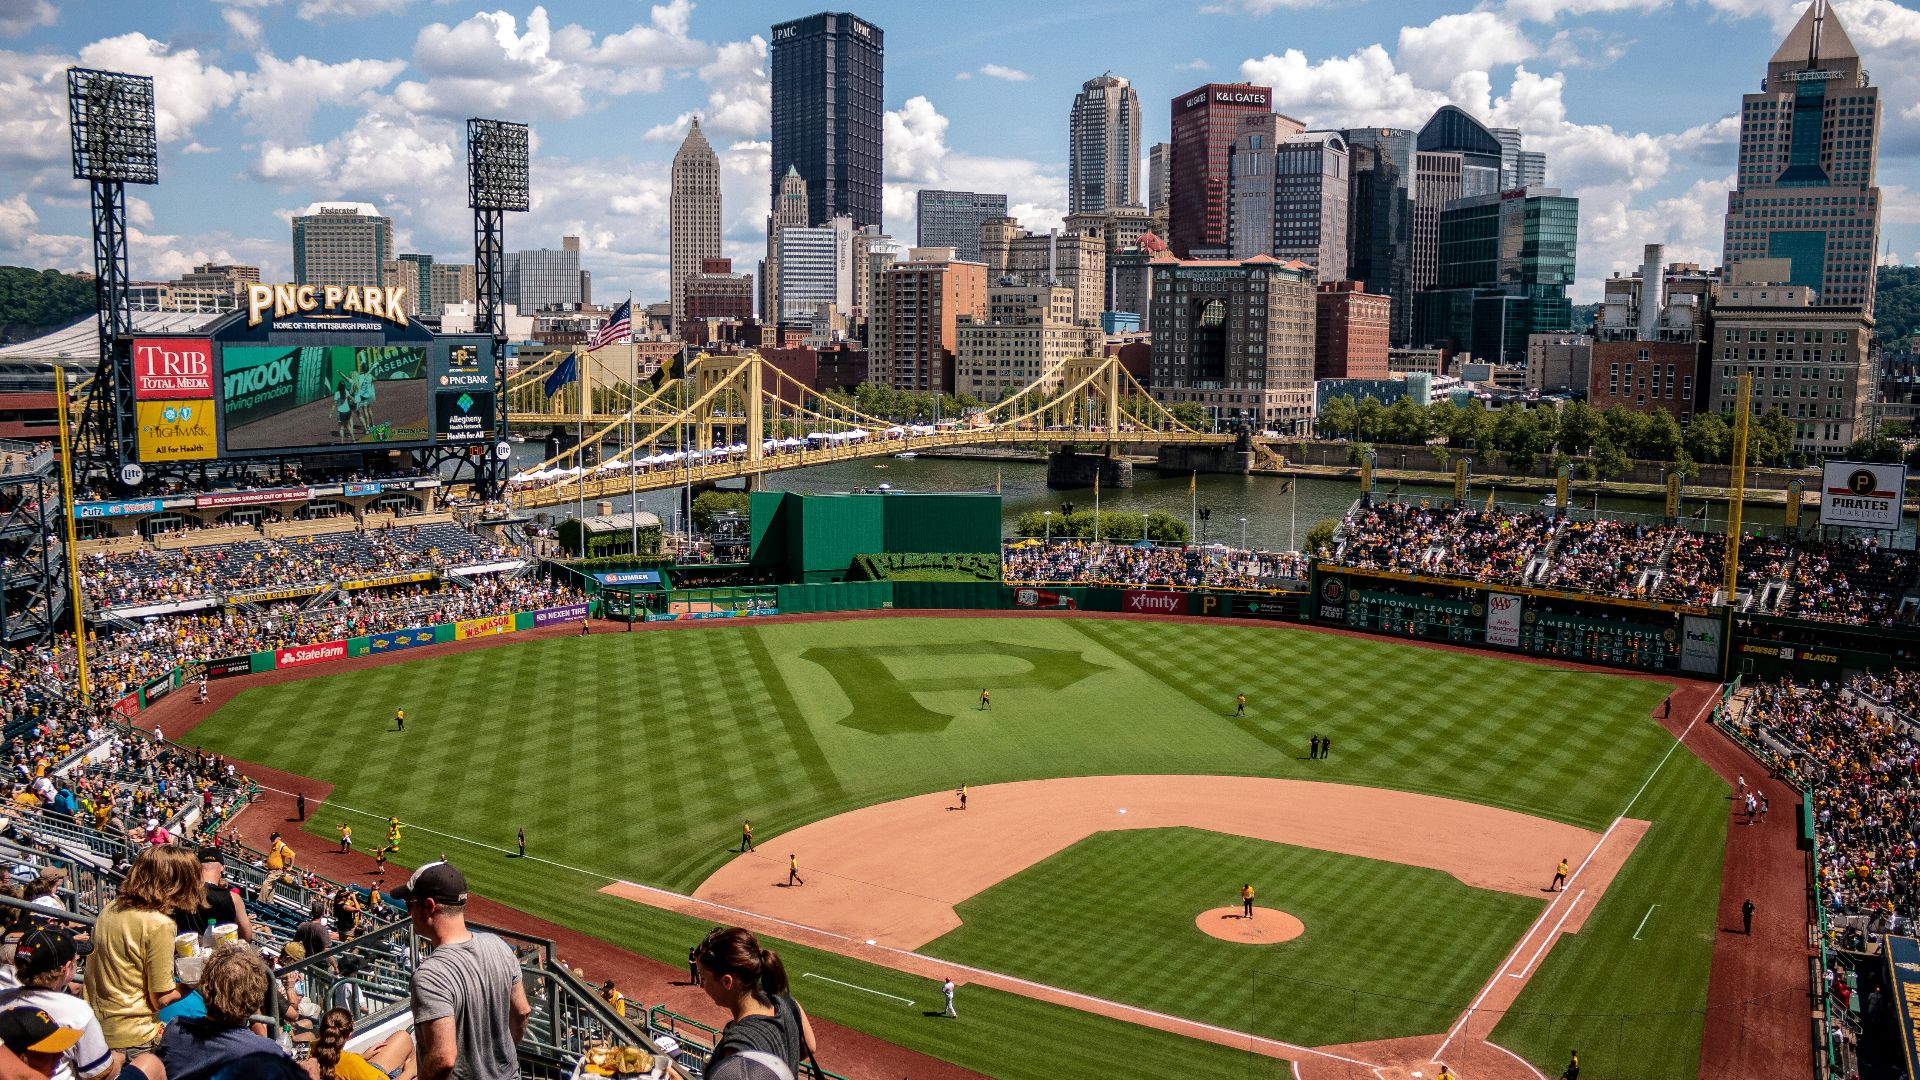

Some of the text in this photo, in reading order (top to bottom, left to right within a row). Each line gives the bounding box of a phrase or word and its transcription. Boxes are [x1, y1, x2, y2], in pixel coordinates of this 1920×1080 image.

[853, 20, 871, 39] UPMC
[1216, 92, 1266, 104] K&L GATES
[1390, 128, 1405, 138] PNC
[320, 206, 359, 214] Federated
[247, 284, 410, 327] PNC PARK
[273, 322, 292, 330] HOME
[293, 322, 302, 330] OF
[303, 322, 316, 330] THE
[138, 346, 208, 376] TRIB
[140, 377, 209, 389] TOTAL MEDIA
[449, 375, 488, 385] PNC BANK
[254, 383, 293, 402] emotion
[449, 415, 482, 424] Allegheny
[148, 426, 208, 438] HIGHMARK
[446, 430, 484, 441] Health for All
[156, 443, 204, 453] All for Health
[497, 446, 510, 456] Lite
[124, 468, 141, 480] Lite
[1856, 475, 1869, 491] P
[214, 496, 242, 504] KNOCKING
[1831, 498, 1889, 511] PIRATES
[1831, 508, 1888, 519] CHARITIES
[371, 578, 393, 587] LIGHT
[394, 574, 413, 584] BEER
[245, 593, 268, 601] IRON
[270, 591, 293, 600] CITY
[1131, 593, 1179, 612] xfinity
[1203, 596, 1217, 614] P
[1361, 596, 1420, 610] NATIONAL
[1424, 604, 1469, 616] LEAGUE
[1491, 597, 1510, 611] AAA
[548, 610, 570, 619] NEXEN
[571, 607, 586, 616] TIRE
[1320, 605, 1345, 614] FREAKY
[1320, 610, 1343, 619] FAST!
[1488, 624, 1519, 633] Insurance
[1538, 619, 1605, 633] AMERICAN
[1610, 628, 1661, 641] LEAGUE
[1687, 630, 1715, 642] FedEx
[1743, 644, 1779, 656] BOWSER
[1803, 652, 1838, 663] BLASTS
[228, 665, 249, 673] SPORTS
